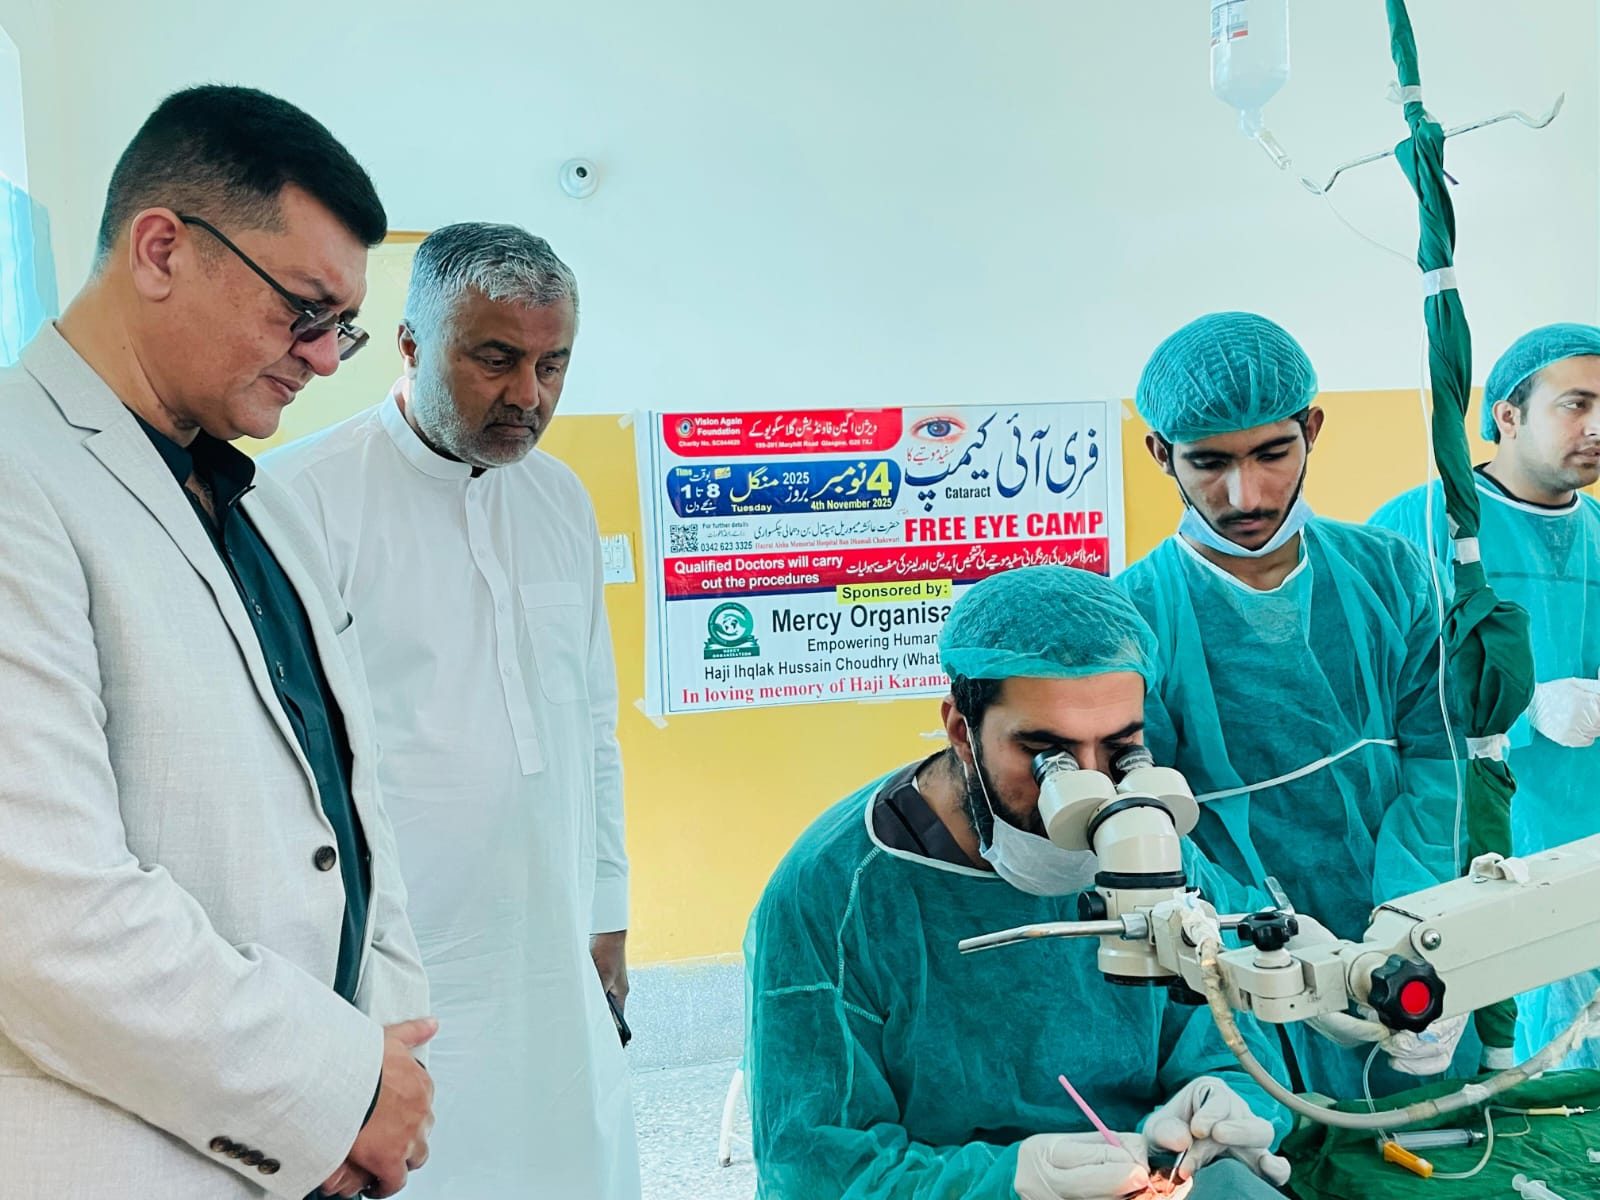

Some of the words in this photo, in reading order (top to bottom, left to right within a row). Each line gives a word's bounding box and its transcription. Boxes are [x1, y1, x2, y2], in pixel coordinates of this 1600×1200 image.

[695, 417, 719, 426] Vision
[720, 416, 743, 427] Again
[697, 427, 741, 436] Foundation
[904, 411, 998, 512] کیمپ
[996, 412, 1051, 499] آئی
[1046, 427, 1099, 500] فری
[729, 465, 780, 503] منگل
[782, 471, 810, 486] 2025
[810, 461, 867, 499] نومبر
[866, 461, 893, 497] 4
[680, 483, 692, 499] 1
[706, 483, 721, 498] 8
[784, 485, 809, 503] بروز
[945, 485, 991, 500] Cataract
[685, 501, 700, 514] دن
[731, 503, 772, 513] Tuesday
[810, 500, 825, 511] 4th
[827, 499, 871, 511] November
[872, 498, 893, 508] 2025
[876, 520, 901, 535] حضرت
[905, 516, 967, 543] FREE
[974, 514, 1019, 540] EYE
[1026, 511, 1104, 537] CAMP
[700, 543, 719, 552] 0342
[720, 542, 734, 551] 623
[735, 541, 753, 551] 3325
[674, 560, 733, 575] Qualified
[735, 557, 785, 571] Doctors
[787, 555, 809, 569] will
[812, 556, 843, 570] carry
[701, 576, 722, 590] out
[725, 575, 745, 589] the
[749, 572, 820, 591] procedures
[842, 583, 921, 602] Sponsored
[926, 582, 949, 597] by:
[772, 608, 842, 636] Mercy
[807, 635, 890, 654] Empowering
[893, 631, 940, 647] Human
[704, 664, 731, 683] Haji
[734, 661, 775, 680] Ihqlak
[778, 655, 832, 675] Hussain
[835, 651, 899, 673] Choudhry
[682, 687, 700, 705] In
[704, 685, 755, 704] loving
[759, 680, 825, 700] memory
[829, 677, 847, 693] of
[850, 675, 884, 694] Haji
